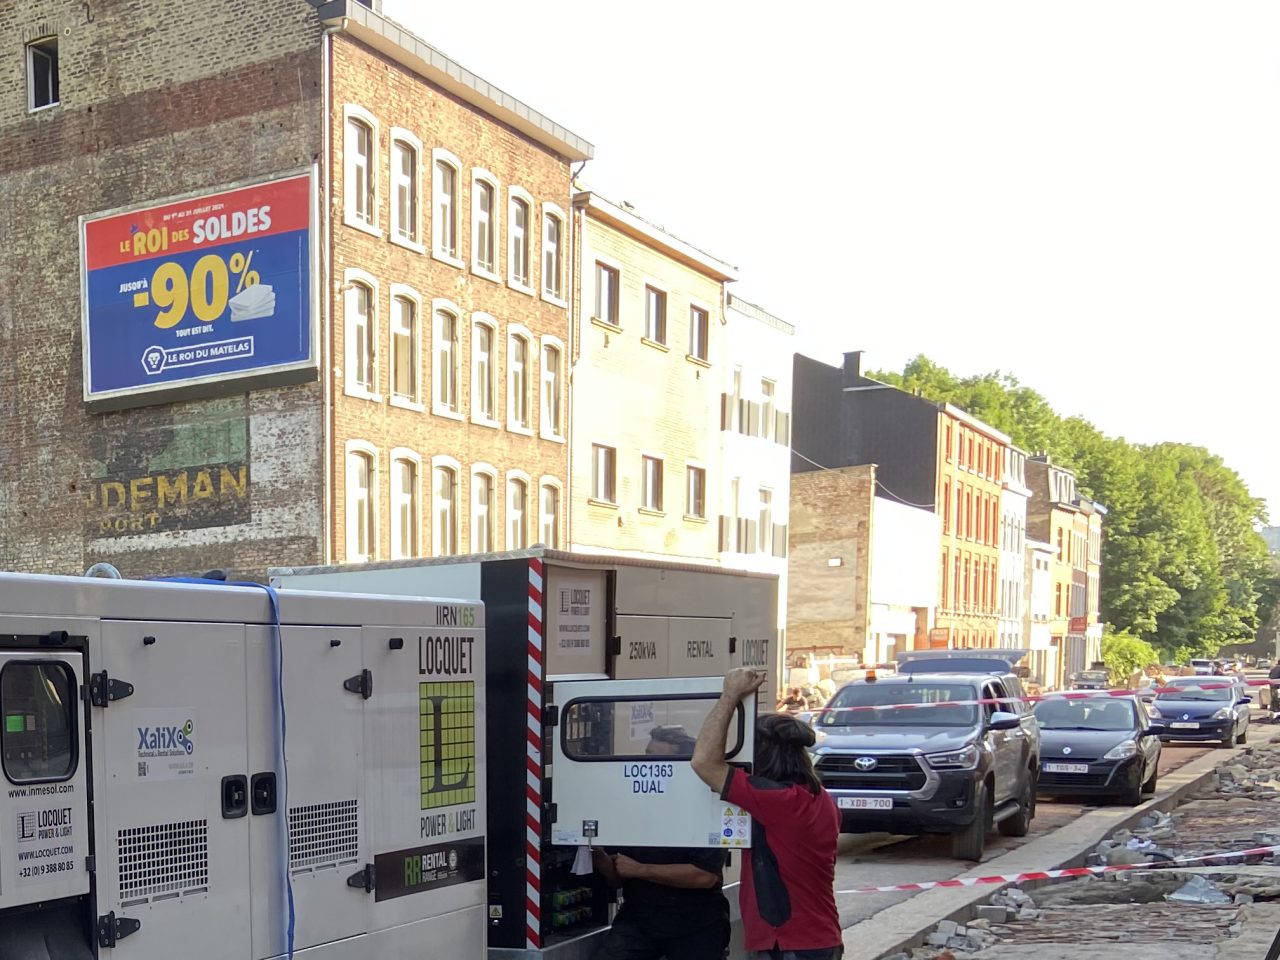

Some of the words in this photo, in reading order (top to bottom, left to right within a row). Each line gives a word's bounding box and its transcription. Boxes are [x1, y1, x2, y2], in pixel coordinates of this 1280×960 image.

[120, 240, 130, 253] LE
[133, 226, 169, 256] ROI
[172, 229, 190, 242] DES
[192, 206, 272, 244] SOLDES
[120, 278, 148, 293] JUSQU'À
[176, 329, 190, 338] TOUT
[192, 326, 202, 336] EST
[168, 354, 178, 362] LE
[180, 352, 194, 361] ROI
[196, 350, 208, 358] DU
[210, 342, 250, 356] MATELAS
[418, 636, 474, 676] LOCQUET
[630, 641, 656, 660] 250kVA
[687, 640, 714, 658] RENTAL
[138, 726, 177, 750] XaliX
[624, 764, 673, 778] LOC1363
[8, 784, 74, 798] www.inmesol.com
[633, 780, 664, 793] DUAL
[840, 799, 891, 808] 1-XDB-700
[20, 816, 34, 838] L
[38, 808, 72, 828] LOCQUET
[421, 814, 446, 838] POWER
[456, 809, 476, 832] LIGHT
[38, 828, 54, 840] POWER
[54, 828, 59, 838] &
[60, 826, 72, 837] LIGHT
[18, 846, 74, 861] WWW.LOCQUET.COM
[422, 851, 448, 870] RENTAL
[20, 868, 31, 878] +32
[32, 866, 40, 877] (0)
[41, 865, 44, 874] 9
[46, 864, 58, 874] 388
[58, 862, 66, 872] 80
[66, 861, 74, 871] 85
